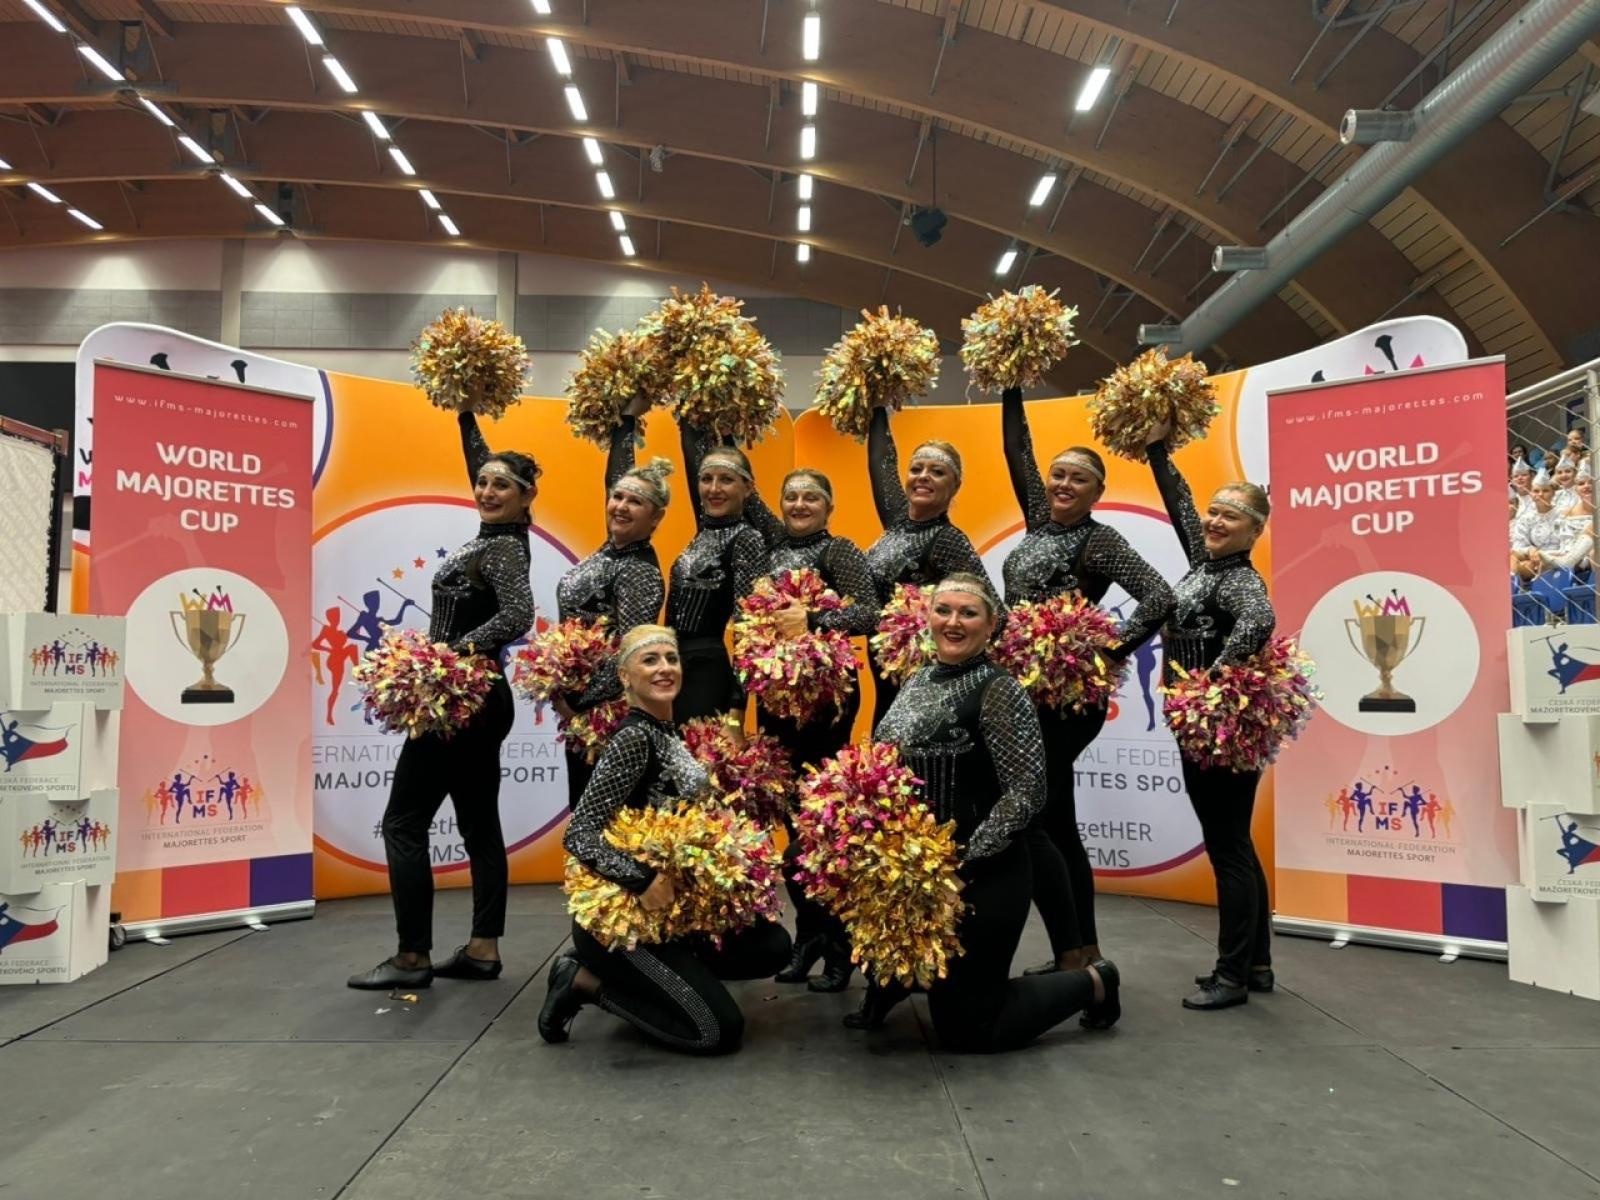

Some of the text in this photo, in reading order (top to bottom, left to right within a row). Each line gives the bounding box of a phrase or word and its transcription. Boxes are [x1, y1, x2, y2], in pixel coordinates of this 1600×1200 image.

[114, 395, 298, 429] www.ifms-majorettes.com
[1285, 391, 1484, 424] www.ifms-majorettes.com
[156, 442, 261, 474] WORLD
[1325, 442, 1439, 473] WORLD
[116, 469, 296, 509] MAJORETTES
[1290, 471, 1483, 510] MAJORETTES
[180, 509, 239, 533] CUP
[1351, 510, 1414, 535] CUP
[141, 824, 264, 841] INTERNATIONAL FEDERATION
[163, 834, 248, 849] MAJORETTES SPORT
[1326, 838, 1456, 855] INTERNATIONAL FEDERATION
[1347, 849, 1436, 863] MAJORETTES SPORT
